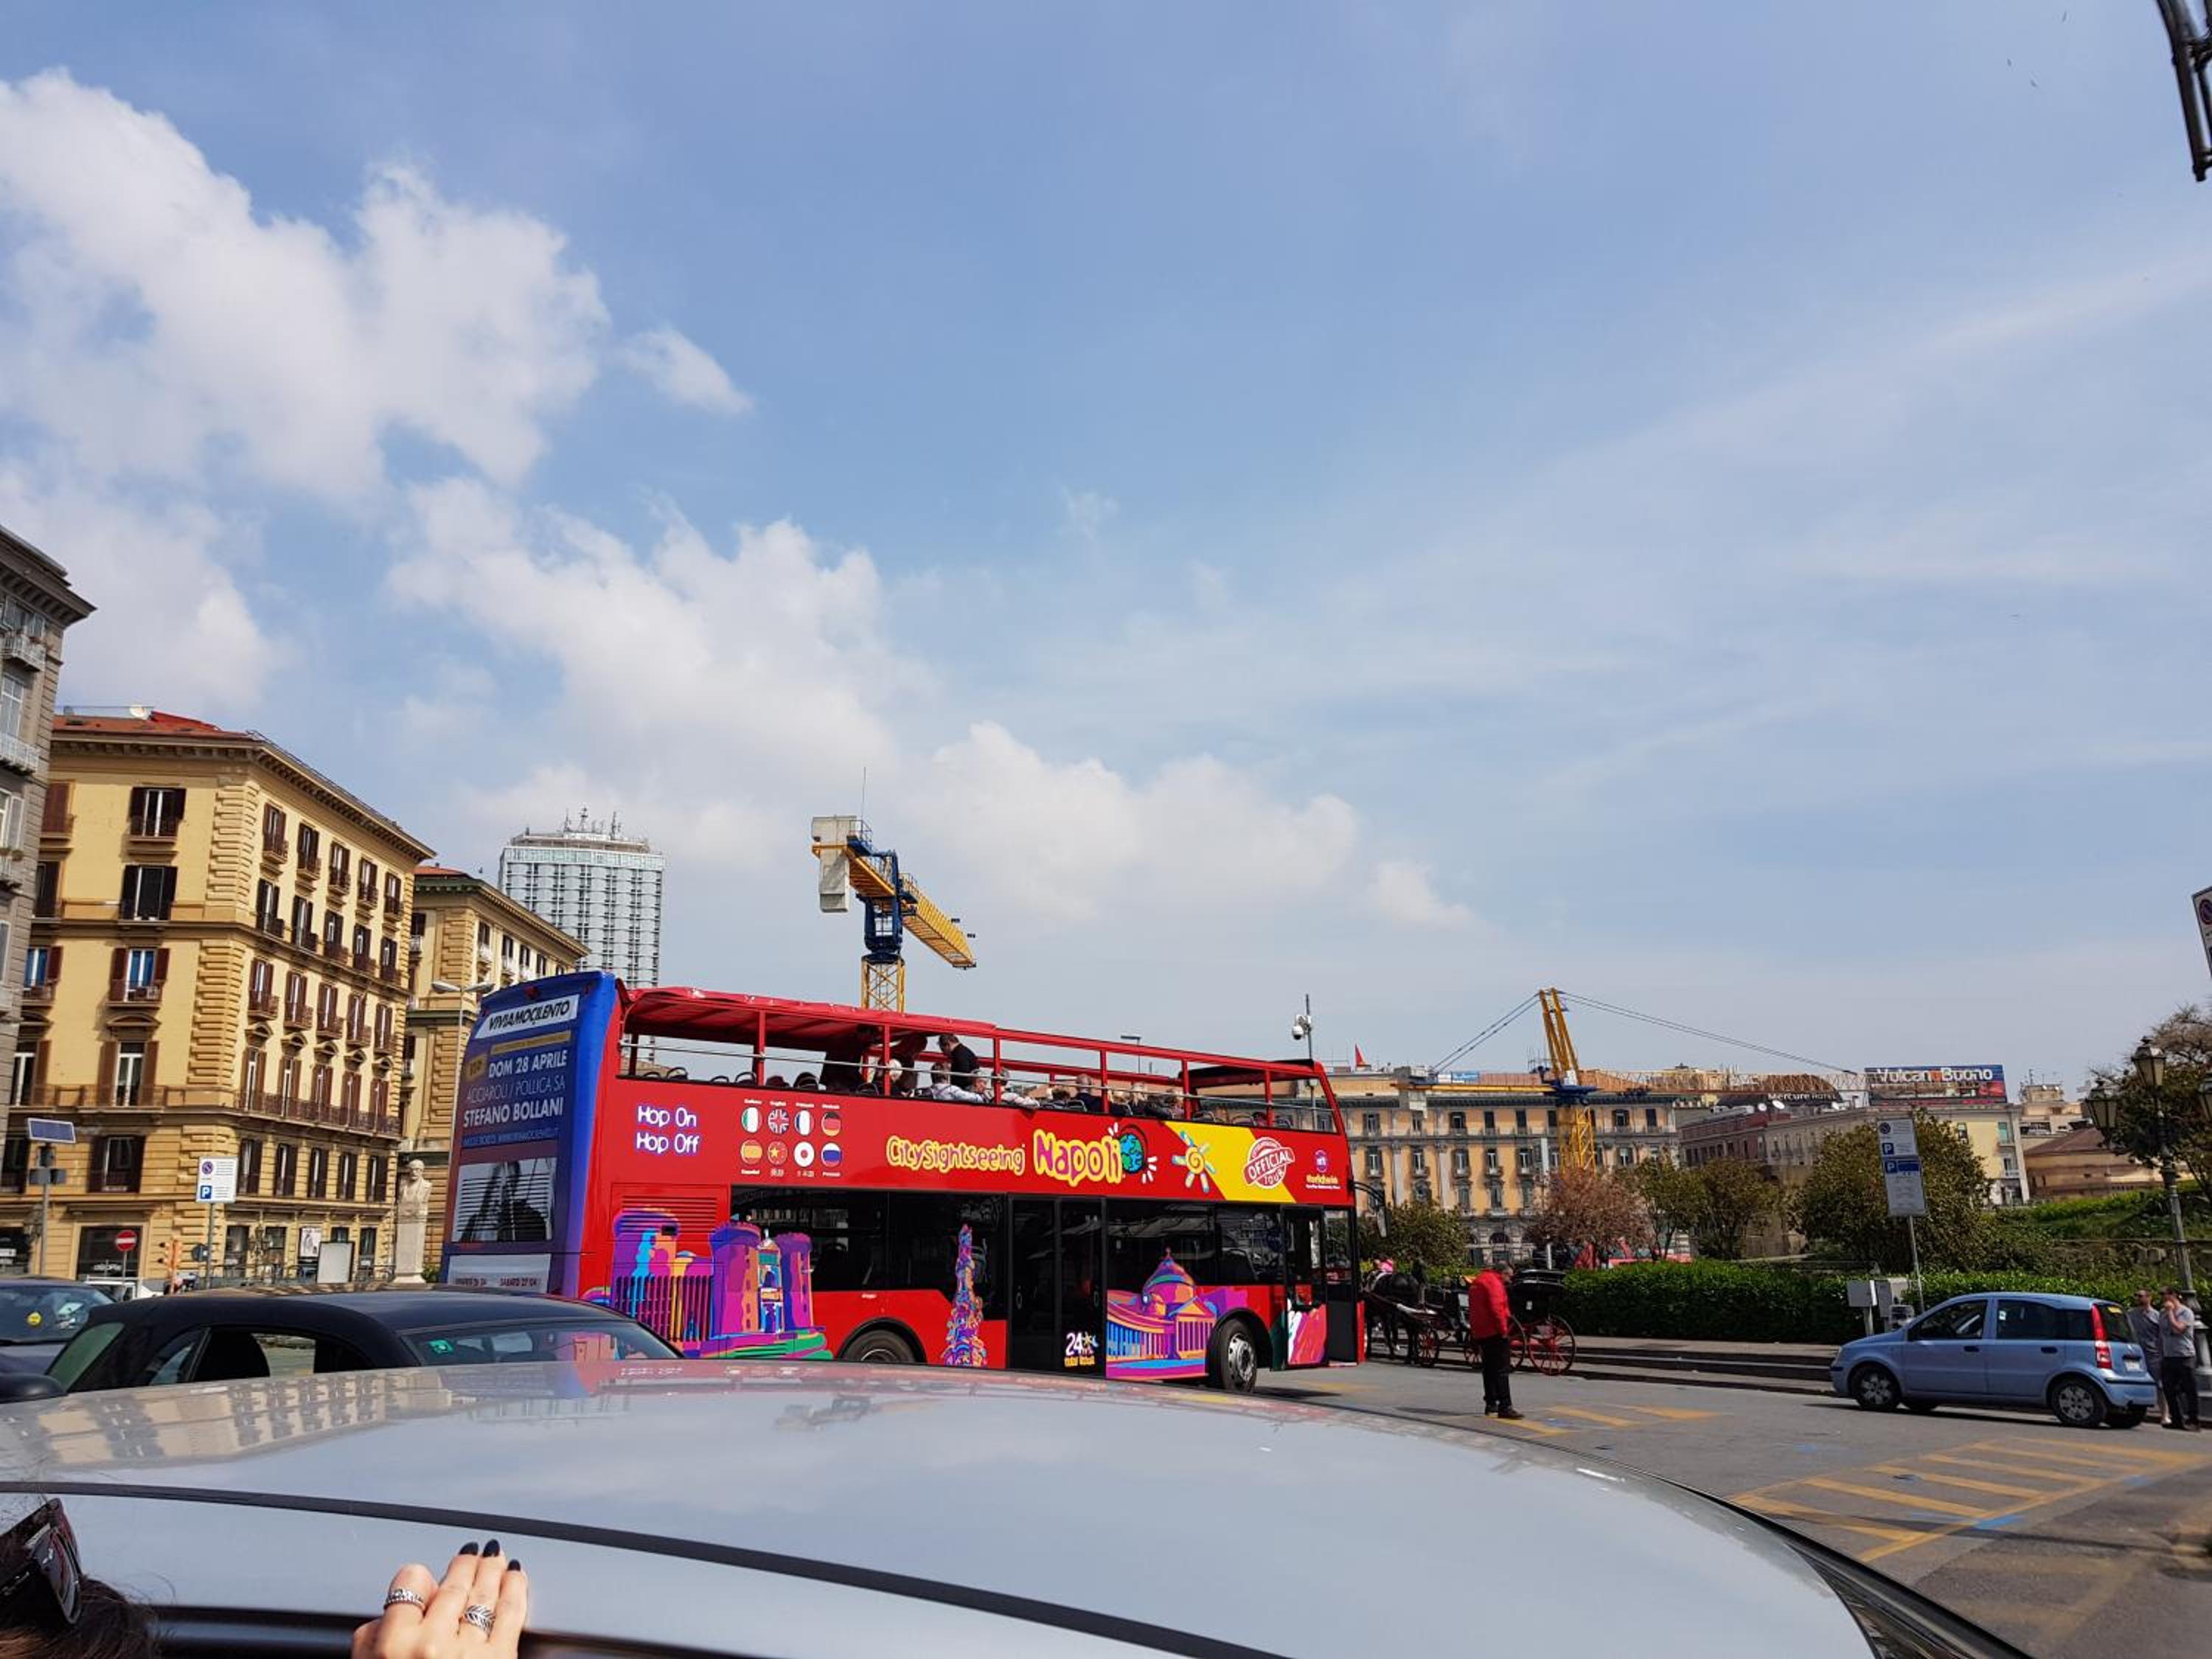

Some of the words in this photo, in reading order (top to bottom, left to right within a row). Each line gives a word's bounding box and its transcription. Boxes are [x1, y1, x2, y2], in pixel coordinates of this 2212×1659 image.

[488, 1058, 512, 1078] DOM
[515, 1056, 529, 1074] 28
[532, 1050, 567, 1071] APRILE
[1941, 1068, 1993, 1082] Buono
[463, 1105, 510, 1128] STEFANO
[512, 1096, 564, 1121] BOLLANI
[637, 1105, 670, 1128] Hop
[675, 1107, 697, 1127] On
[636, 1132, 669, 1154] Hop
[674, 1133, 700, 1153] Off
[886, 1135, 1026, 1176] CitySightseeing
[1033, 1129, 1122, 1187] Napoli
[1248, 1150, 1293, 1179] OFFICIAL
